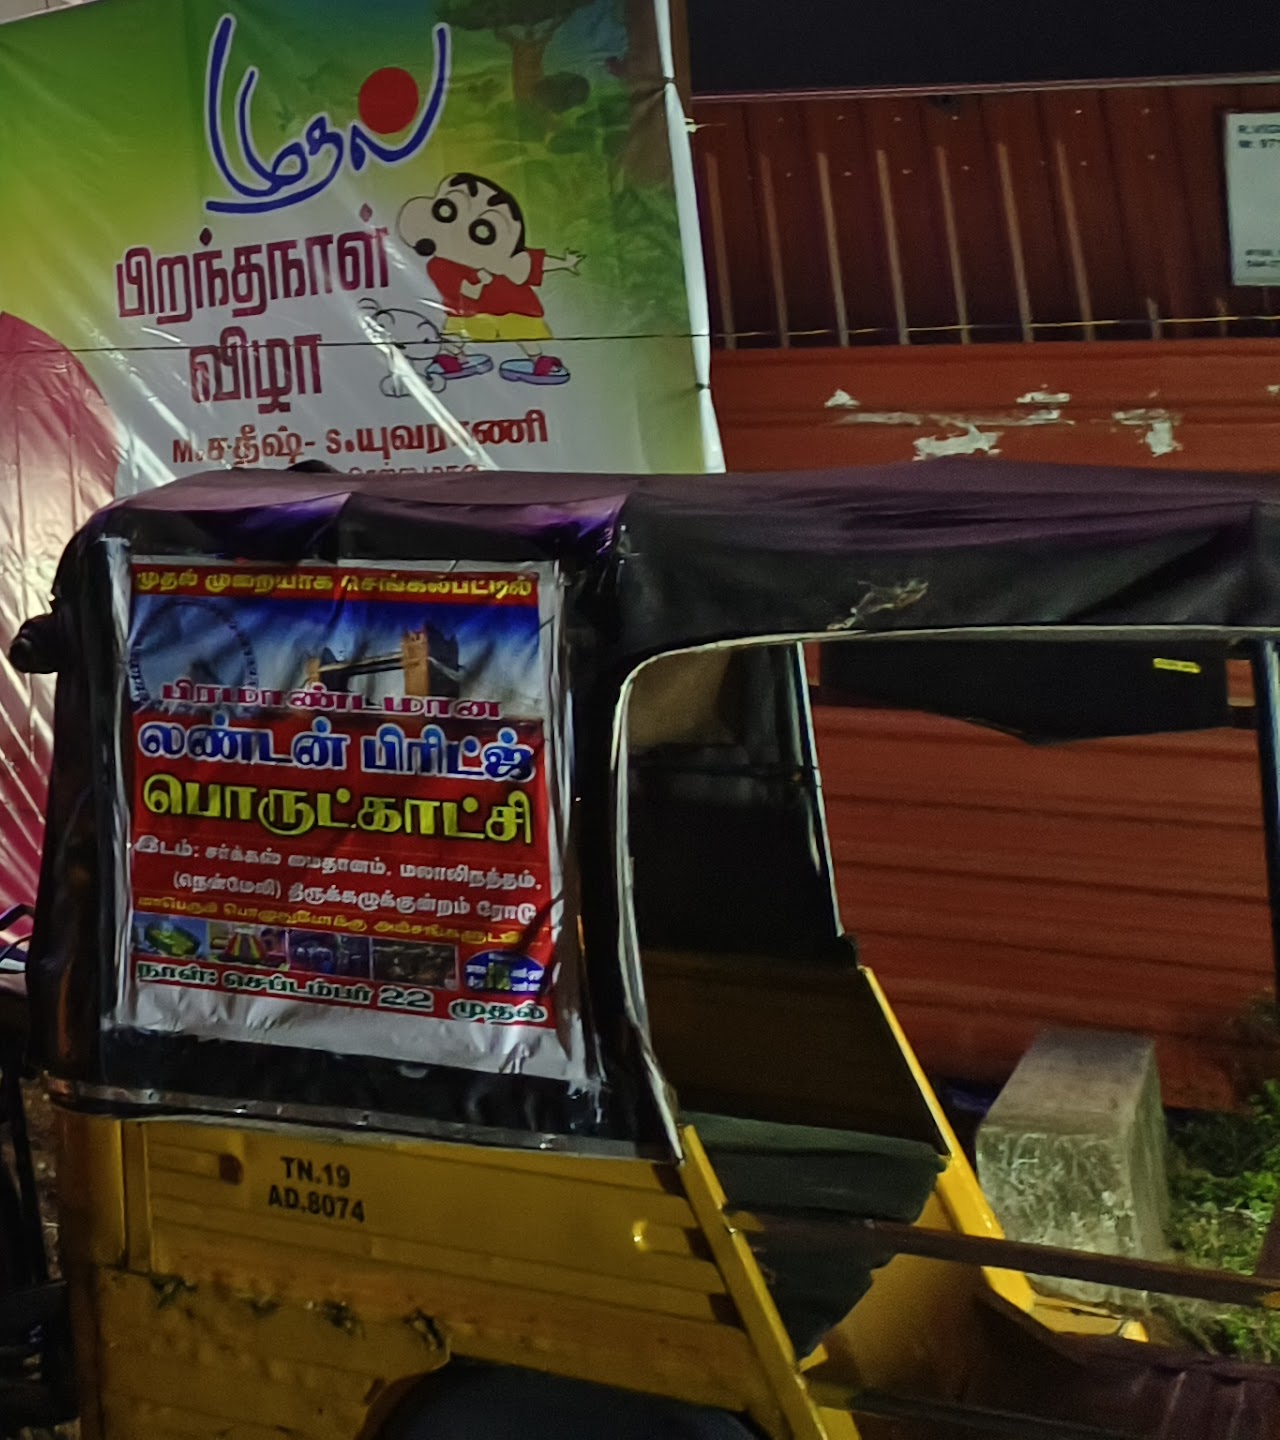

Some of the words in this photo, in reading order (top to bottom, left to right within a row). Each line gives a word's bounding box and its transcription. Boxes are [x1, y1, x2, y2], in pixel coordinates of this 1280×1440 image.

[114, 202, 390, 326] பிறந்தநாள்
[188, 326, 324, 415] விழா
[137, 568, 199, 592] முதல்
[160, 678, 505, 720] பிரமாண்டமான
[137, 712, 349, 772] லண்டன்
[360, 721, 538, 783] பிரிட்ஜ்
[142, 772, 533, 846] பொருட்காட்சி
[134, 834, 200, 858] இடம்:
[476, 900, 539, 926] ரோடு
[223, 971, 374, 1005] செப்டம்பர்
[376, 985, 436, 1012] 22
[447, 998, 548, 1024] முதல்
[280, 1156, 351, 1189] TN.19
[268, 1184, 366, 1224] AD.8074
